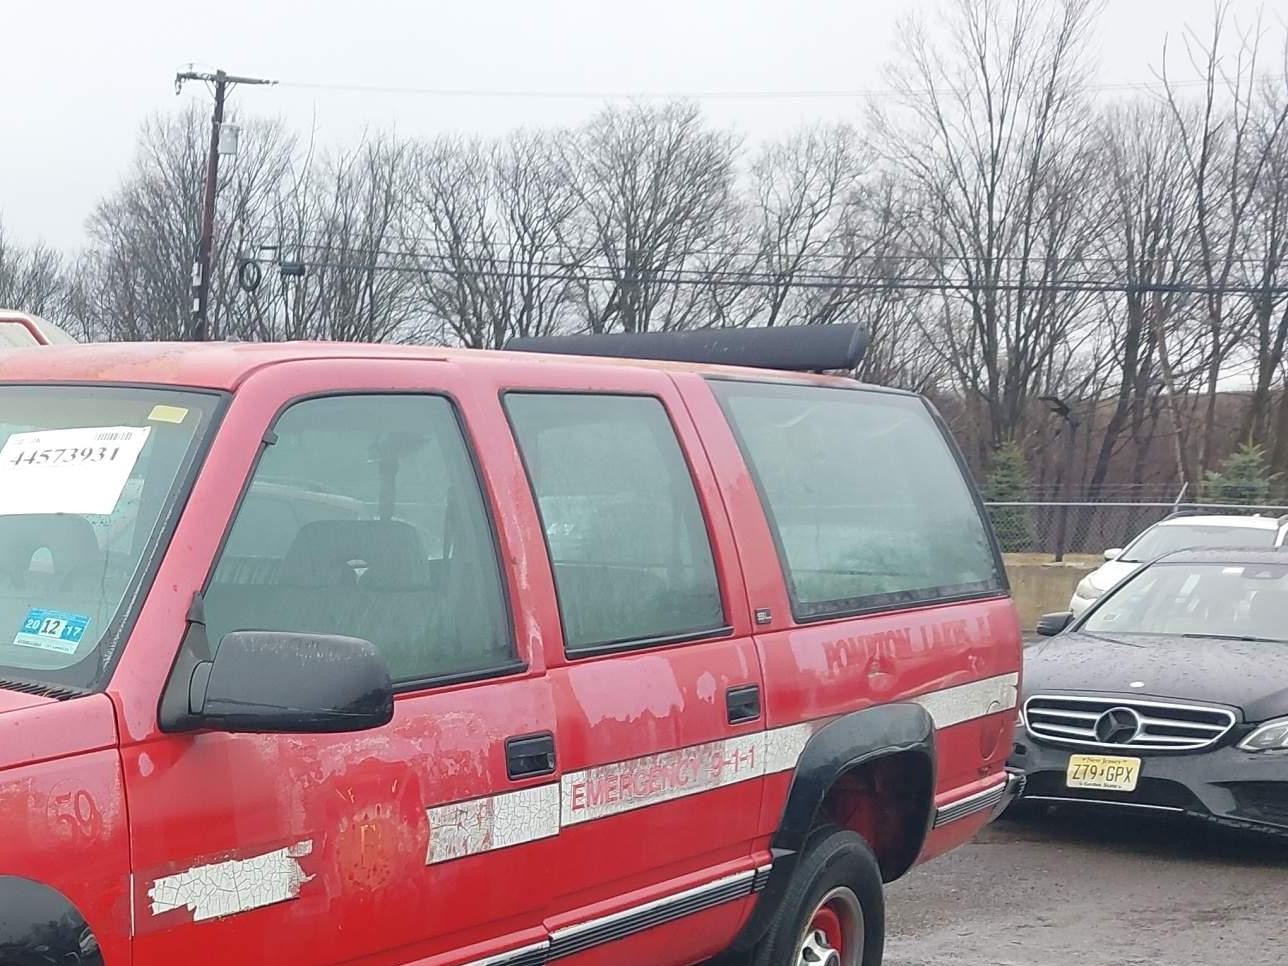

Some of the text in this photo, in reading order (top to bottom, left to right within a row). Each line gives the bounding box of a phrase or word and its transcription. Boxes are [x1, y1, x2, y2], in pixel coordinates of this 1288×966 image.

[10, 446, 121, 467] 44573931
[40, 619, 61, 635] 12
[571, 756, 702, 811] EMERGENCY
